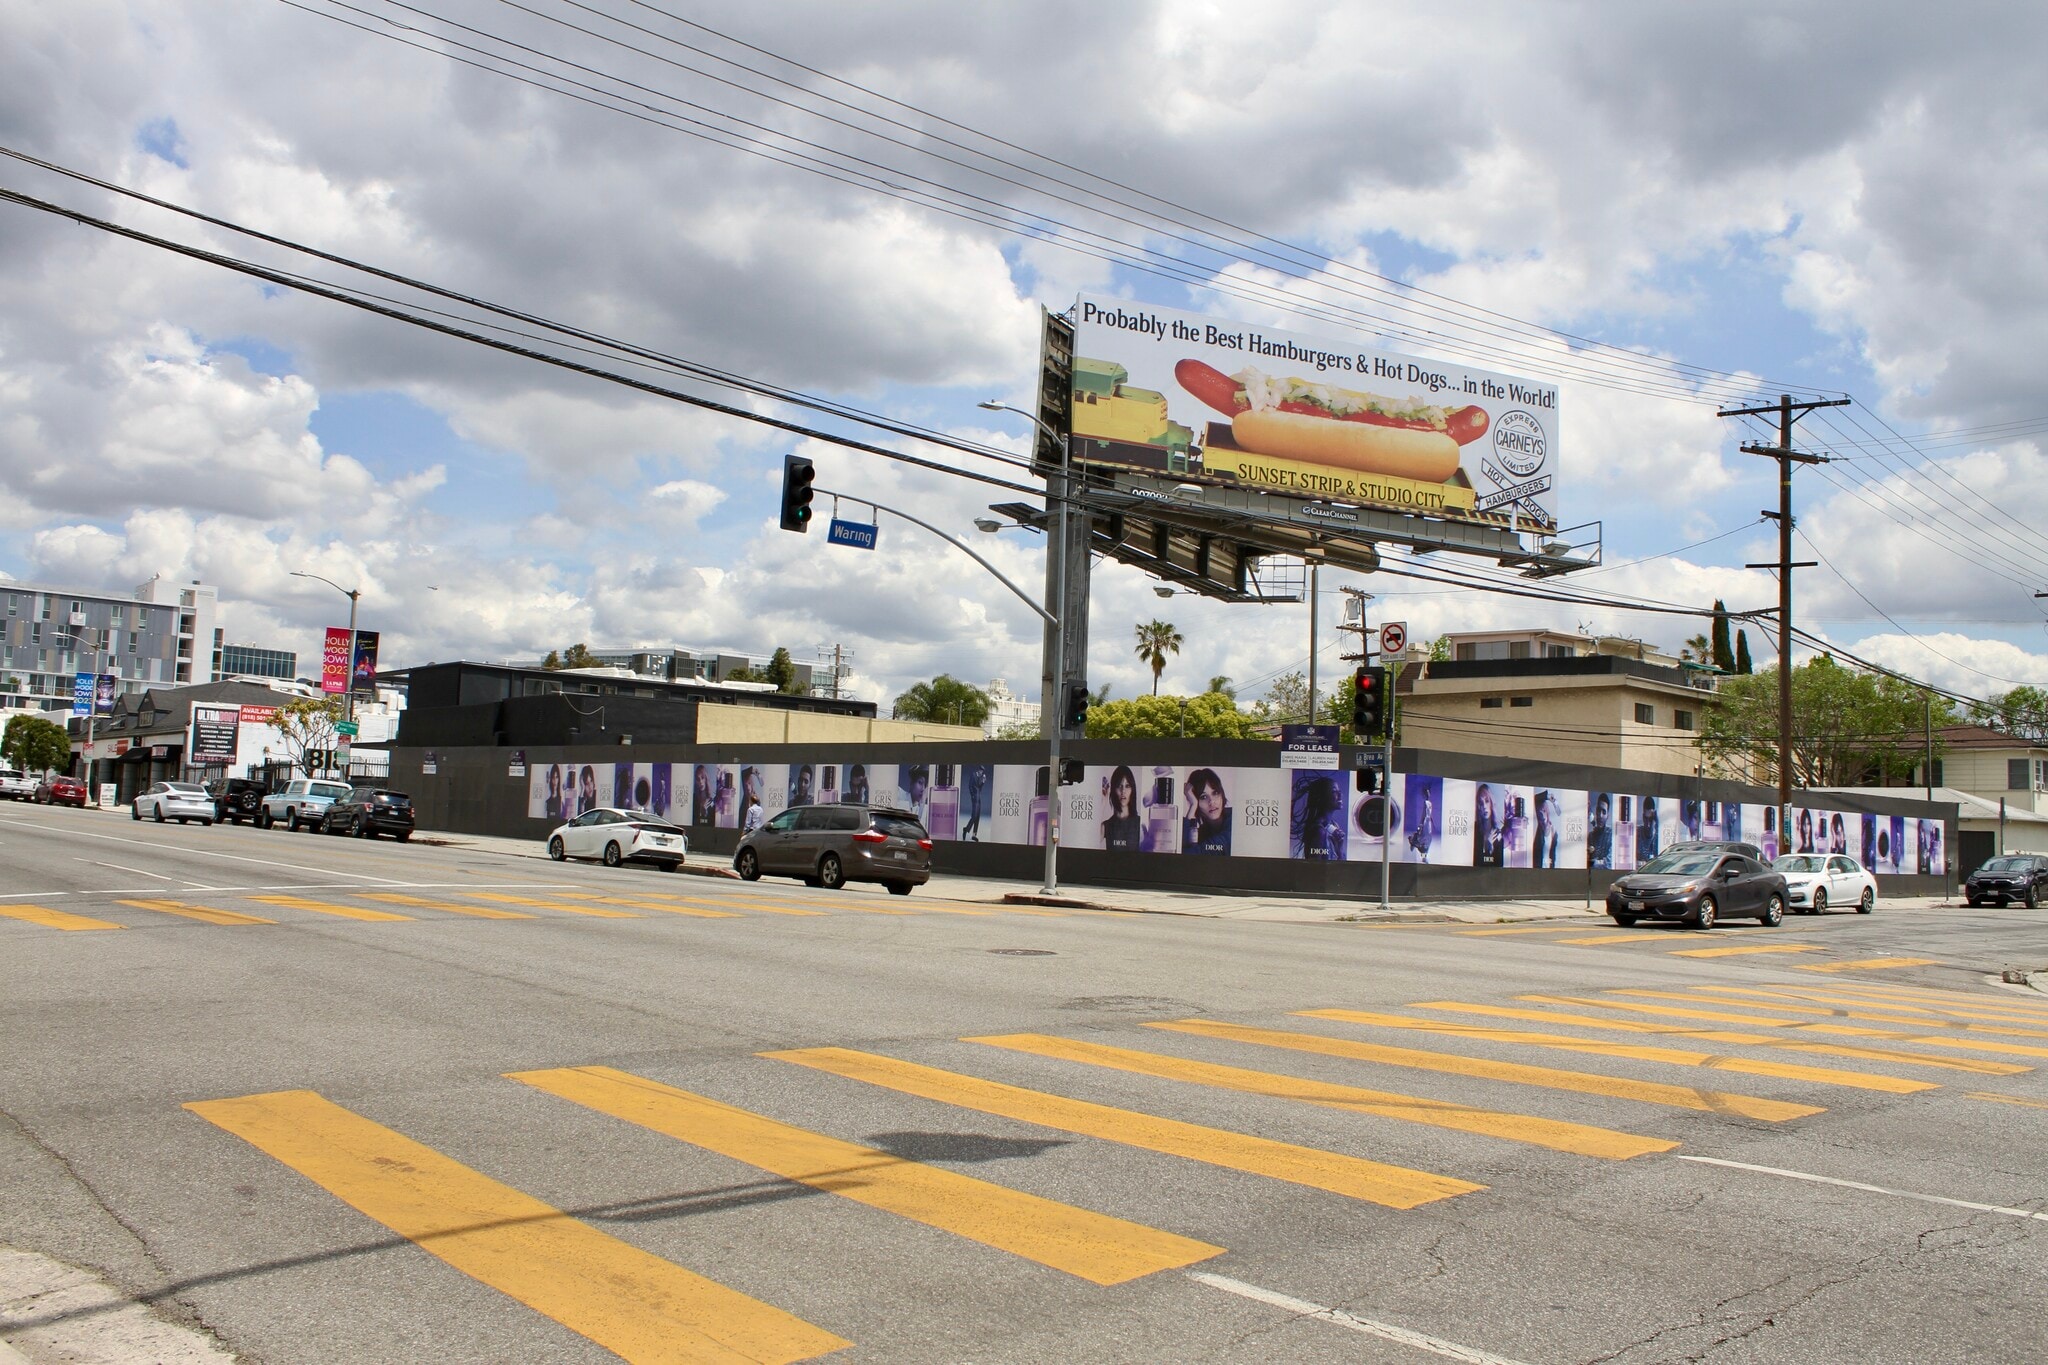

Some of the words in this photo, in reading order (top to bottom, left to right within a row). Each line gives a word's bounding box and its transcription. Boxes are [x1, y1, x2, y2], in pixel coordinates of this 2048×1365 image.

[1084, 302, 1167, 341] Probably
[1172, 320, 1200, 345] the
[1205, 325, 1244, 350] Best
[1248, 333, 1352, 371] Hamburgers
[1356, 354, 1369, 374] &
[1373, 357, 1403, 381] Hot
[1407, 364, 1460, 392] Dogs...
[1463, 375, 1478, 395] in
[1481, 379, 1505, 399] the
[1508, 383, 1556, 409] World!
[1504, 413, 1540, 433] EXPRESS
[1495, 429, 1544, 456] CARNEYS
[1503, 456, 1535, 472] LIMITED
[1487, 467, 1506, 485] HOT
[1238, 463, 1297, 487] SUNSET
[1300, 473, 1342, 493] STRIP
[1345, 481, 1357, 495] &
[1359, 482, 1412, 504] STUDIO
[1414, 494, 1446, 510] CITY
[1485, 479, 1546, 507] HAMBURGERS
[1522, 498, 1547, 523] DOGS
[834, 525, 873, 547] Waring
[1288, 743, 1306, 751] FOR
[1307, 744, 1334, 752] LEASE
[1356, 753, 1363, 761] La
[1364, 753, 1375, 761] Brea
[769, 792, 785, 800] GRIS
[875, 796, 892, 804] GRIS
[769, 800, 785, 808] DIOR
[999, 798, 1020, 808] GRIS
[1070, 800, 1094, 810] GRIS
[1245, 798, 1270, 806] #DARE
[999, 808, 1020, 817] DIOR
[1070, 810, 1094, 820] DIOR
[1245, 805, 1279, 817] GRIS
[1245, 816, 1279, 827] DIOR
[1448, 816, 1469, 826] GRIS
[1448, 826, 1469, 836] DIOR
[1566, 823, 1583, 833] GRIS
[1566, 833, 1583, 842] DIOR
[1205, 844, 1224, 852] DIOR
[1310, 847, 1330, 855] DIOR
